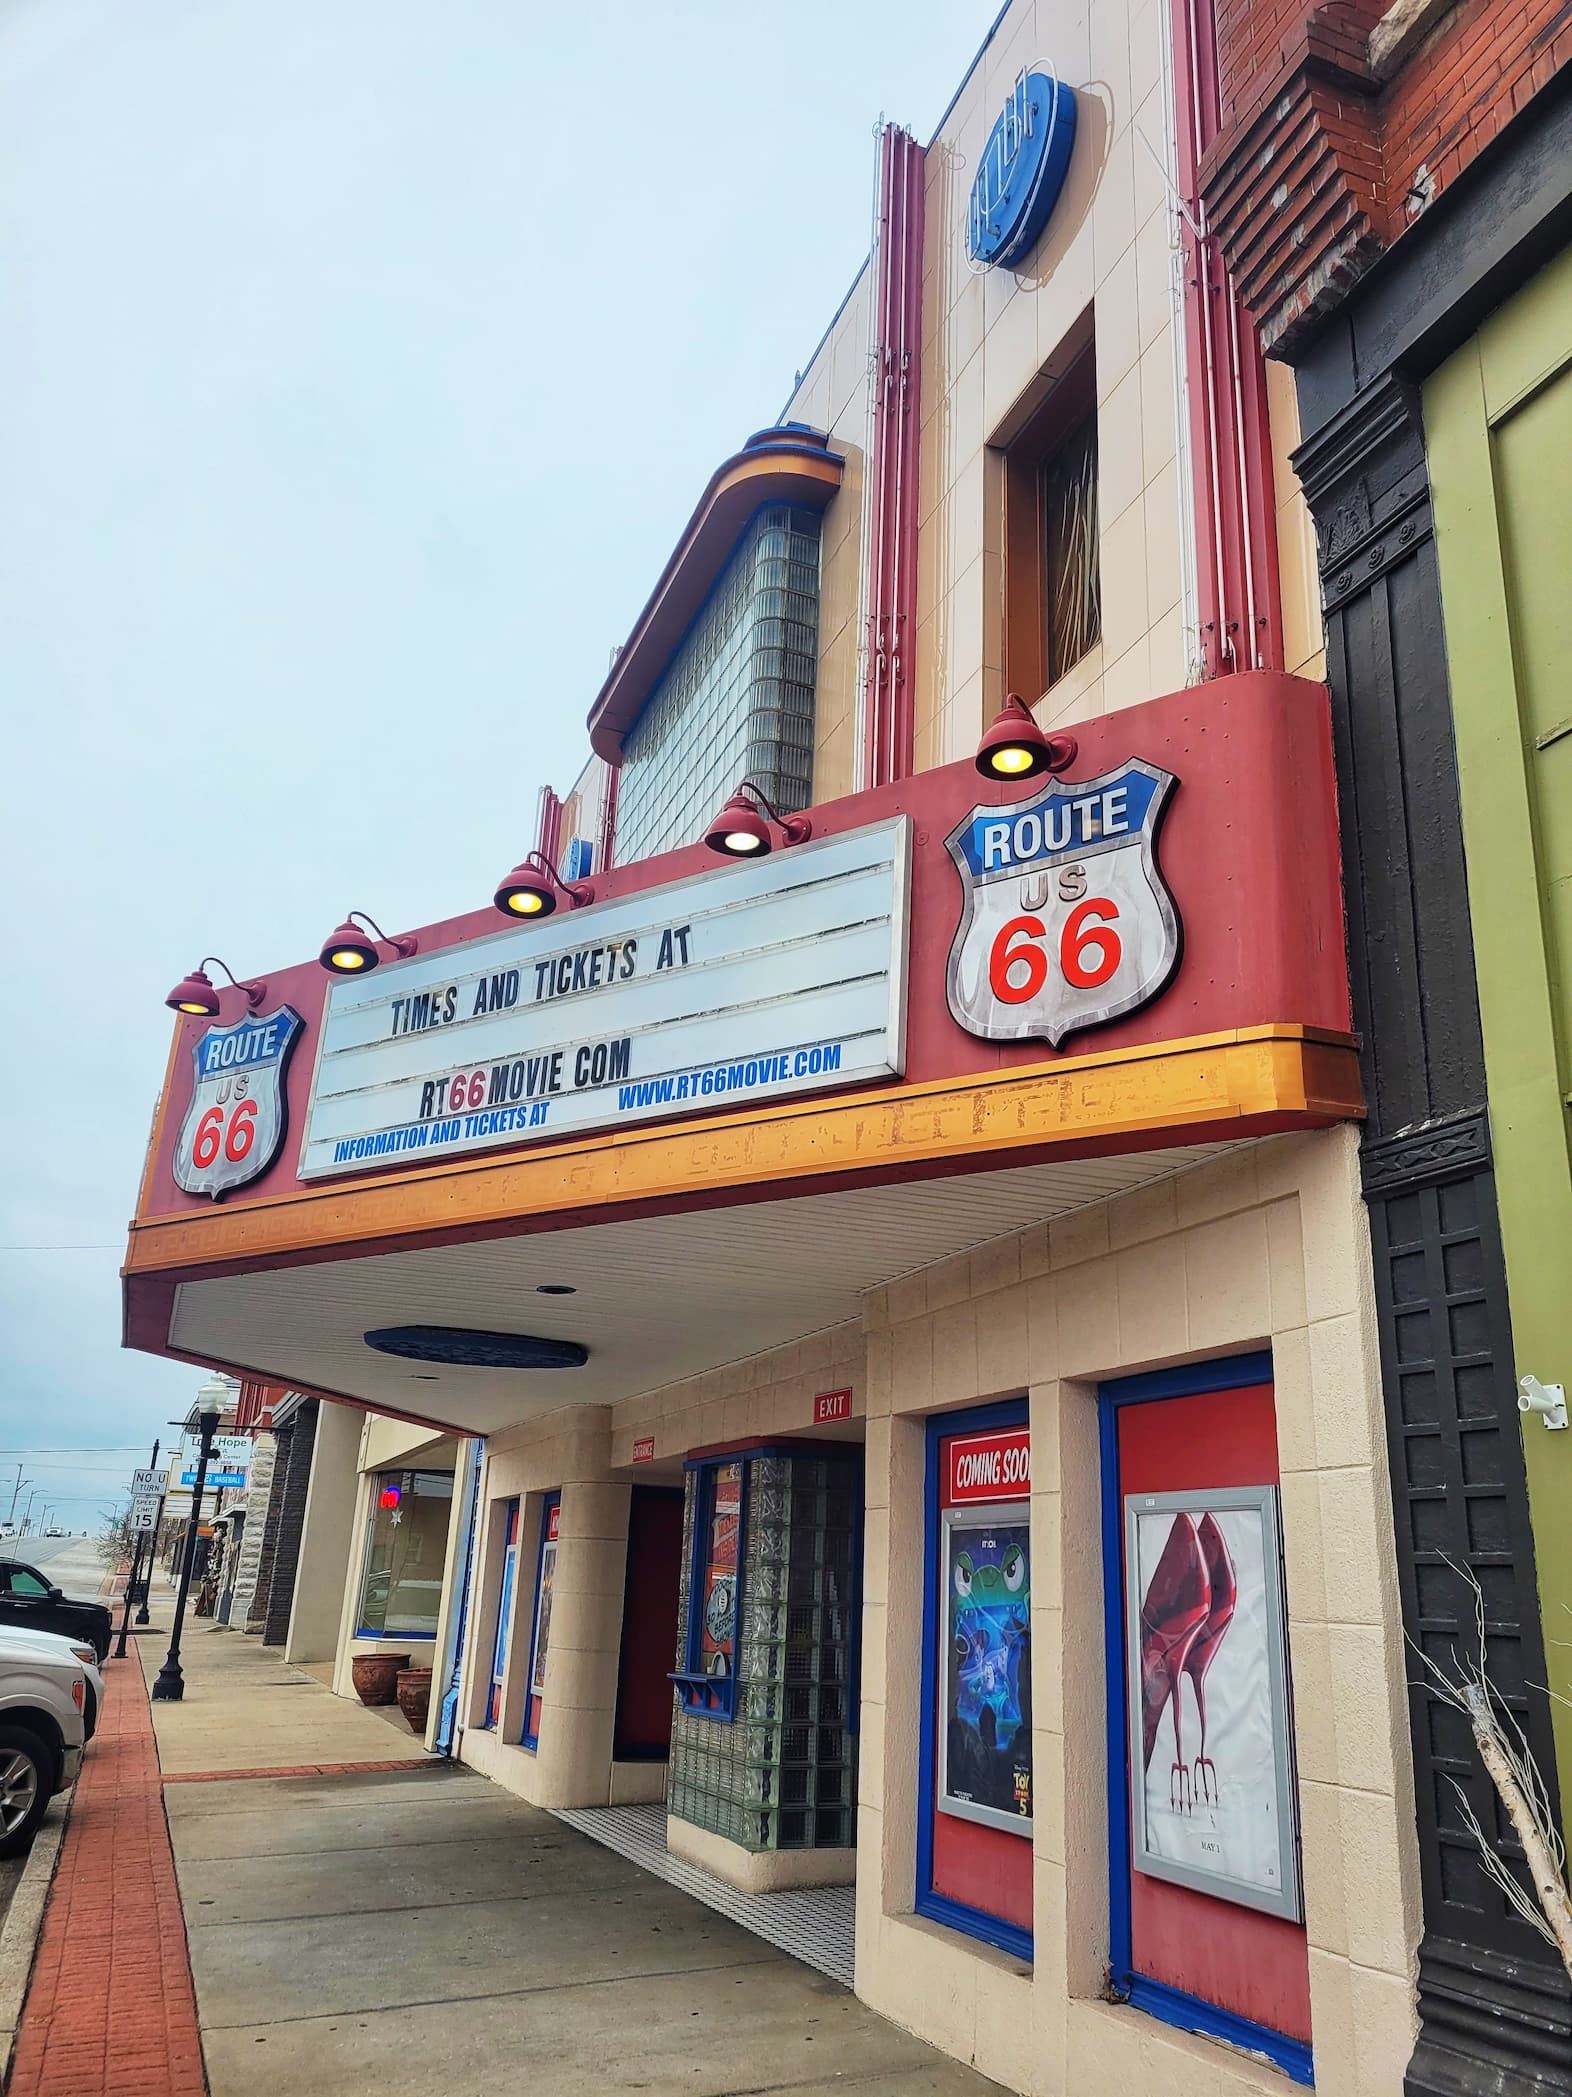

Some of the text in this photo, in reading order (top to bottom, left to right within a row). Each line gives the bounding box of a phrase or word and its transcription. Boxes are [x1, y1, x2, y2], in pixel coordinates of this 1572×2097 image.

[983, 787, 1129, 869] ROUTE
[1018, 865, 1088, 911] US
[988, 896, 1122, 1004] 66
[391, 925, 690, 1035] TIMES AND TICKETS AT
[205, 1024, 279, 1071] ROUTE
[574, 1037, 631, 1088] COM
[215, 1074, 249, 1105] US
[618, 1044, 842, 1111] WWW.RT66MOVIE.COM
[192, 1099, 258, 1169] 66
[333, 1101, 550, 1164] INFORMATION AND TICKETS AT
[819, 1395, 845, 1419] EXIT
[218, 1437, 247, 1448] Hope
[136, 1473, 166, 1483] NO U
[214, 1476, 241, 1484] BASEBALL
[956, 1446, 1031, 1489] COMING SOO
[140, 1484, 160, 1492] TURN
[135, 1514, 152, 1527] 15
[1013, 1772, 1029, 1790] TOY
[1019, 1798, 1027, 1815] 5
[1201, 1841, 1216, 1852] MAY
